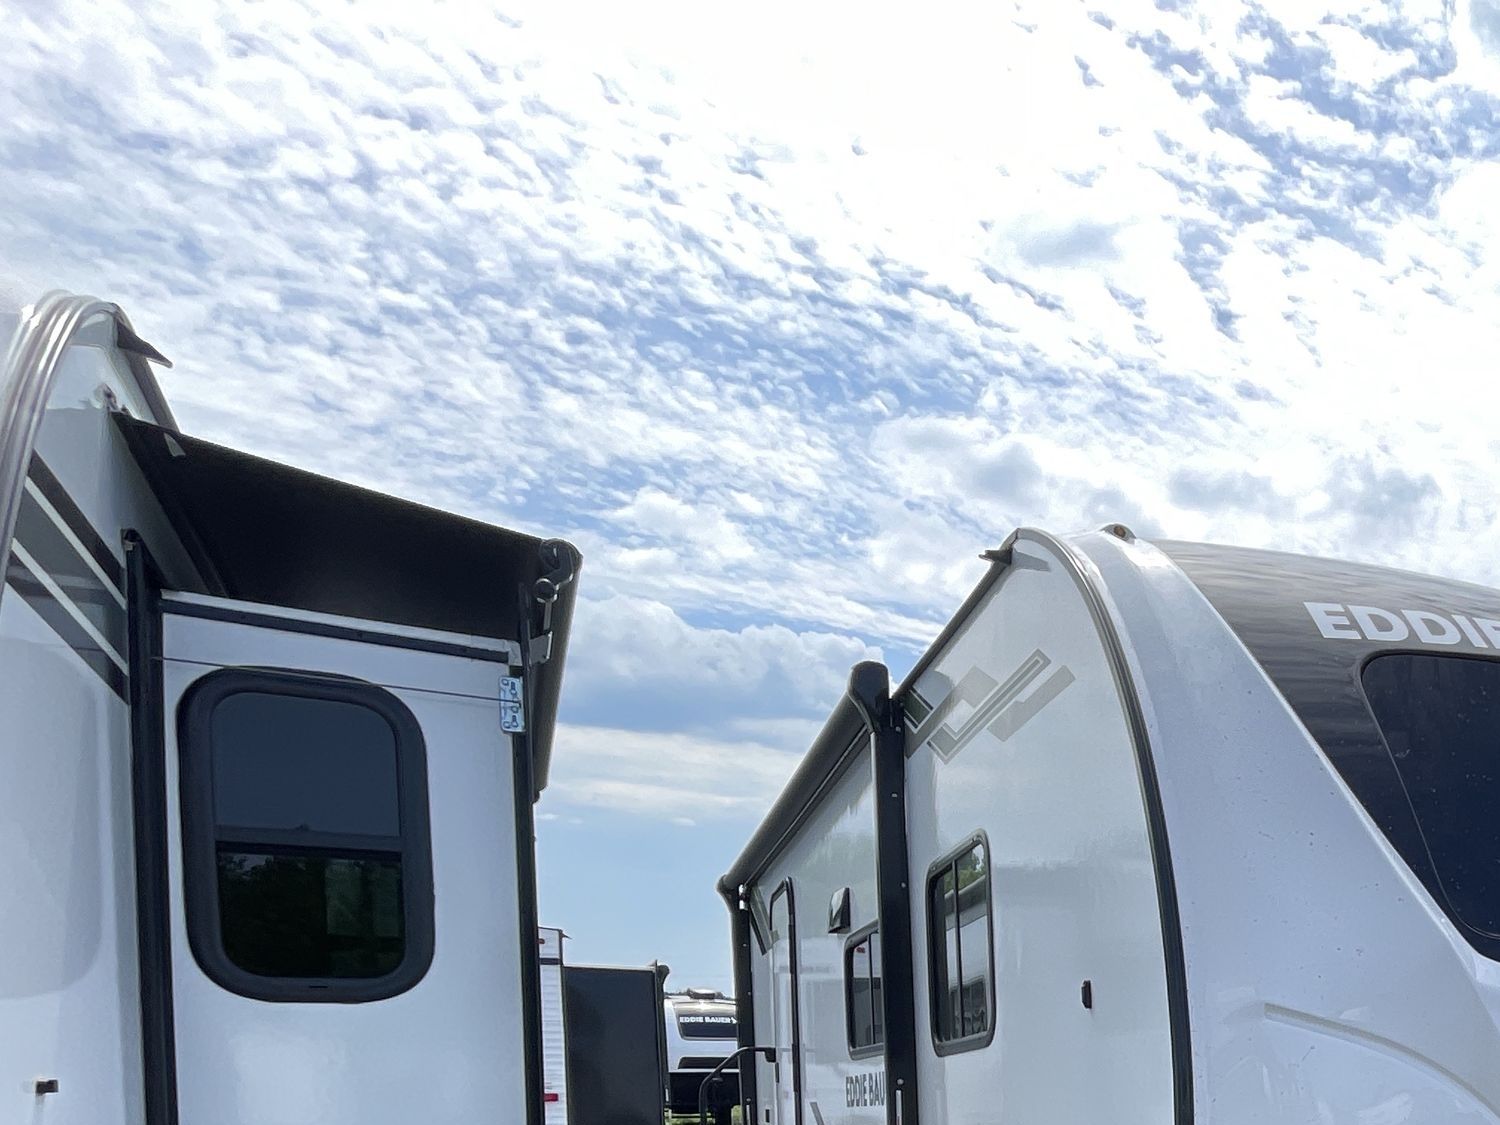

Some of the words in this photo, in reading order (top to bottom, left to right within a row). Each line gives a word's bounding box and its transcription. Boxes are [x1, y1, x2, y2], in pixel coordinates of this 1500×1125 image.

[679, 1016, 704, 1024] EDDIE
[704, 1016, 732, 1024] BAUER
[845, 1074, 868, 1108] EDDIE
[868, 1071, 886, 1107] BAU
